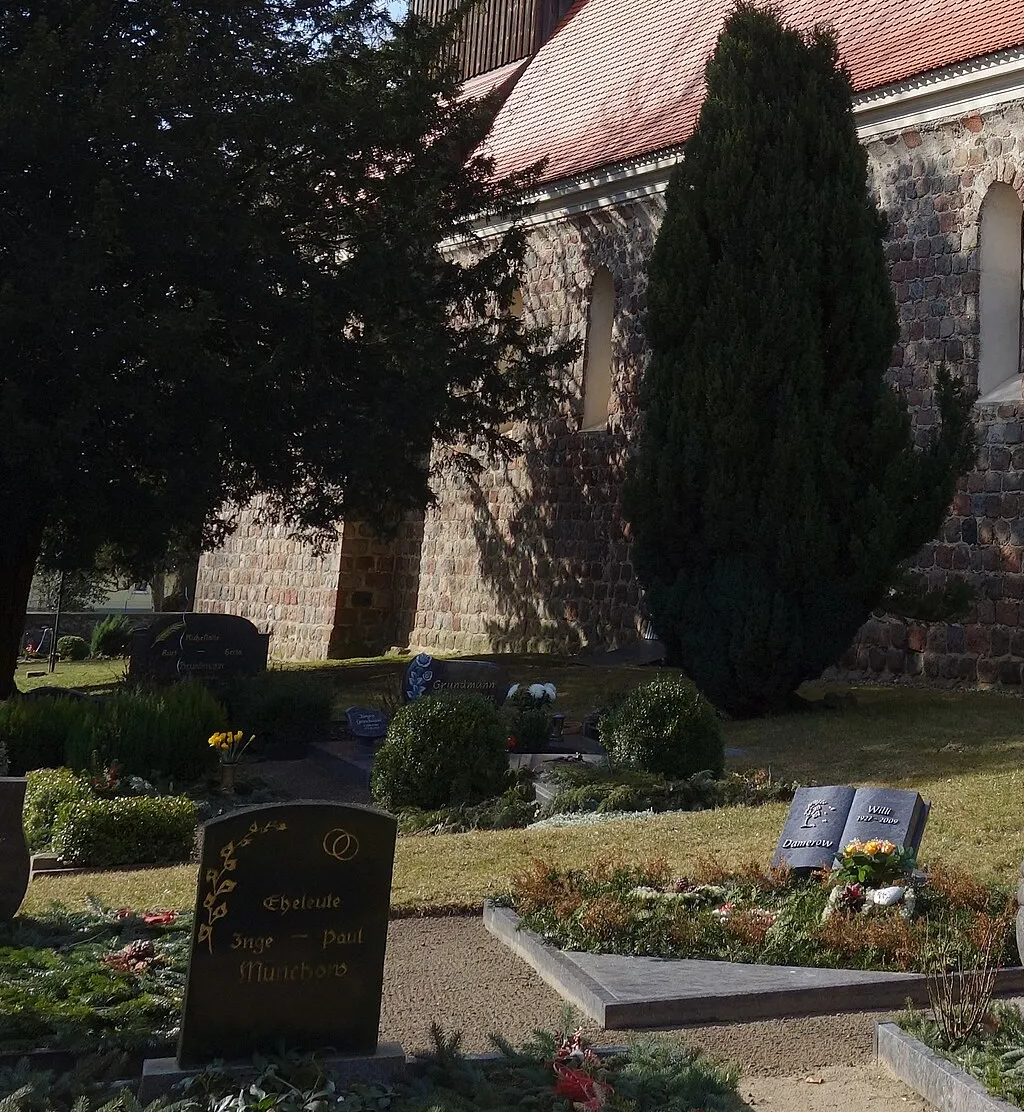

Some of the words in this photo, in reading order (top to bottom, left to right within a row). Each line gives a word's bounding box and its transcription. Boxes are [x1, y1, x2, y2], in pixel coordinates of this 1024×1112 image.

[432, 679, 496, 690] Grundmann
[868, 805, 892, 817] Willi
[263, 892, 343, 916] Eheleute
[230, 932, 274, 954] Inge
